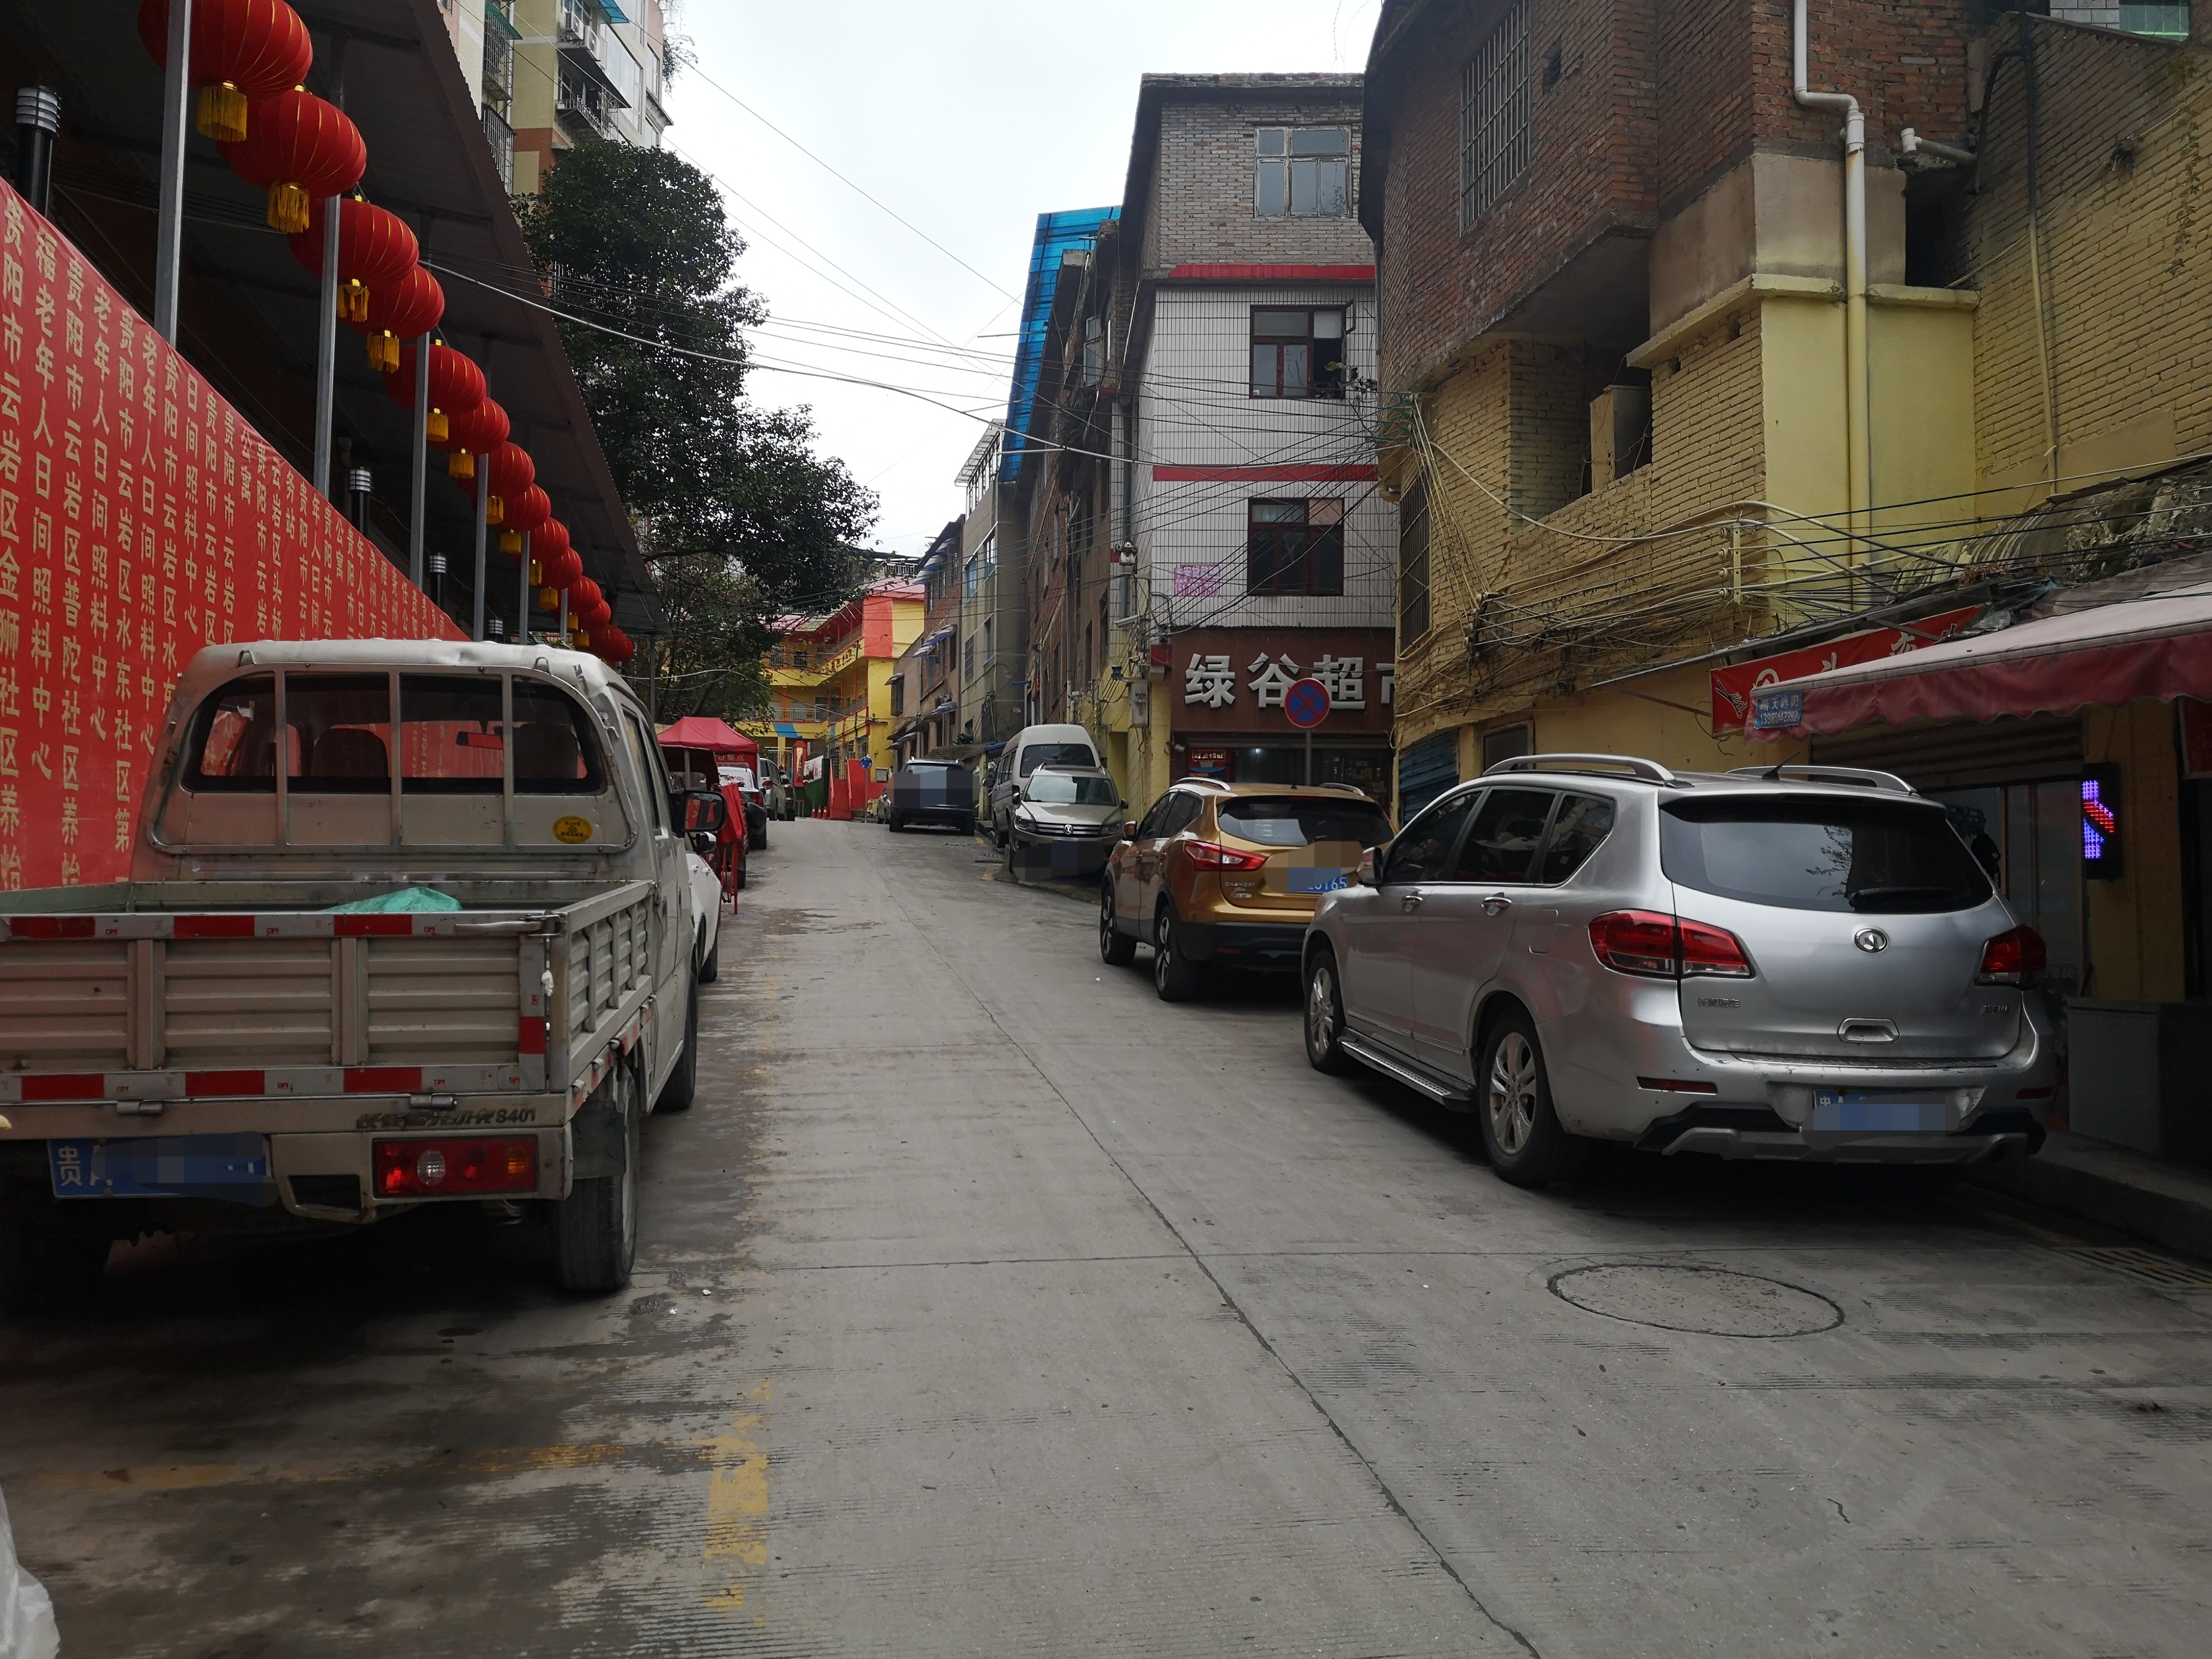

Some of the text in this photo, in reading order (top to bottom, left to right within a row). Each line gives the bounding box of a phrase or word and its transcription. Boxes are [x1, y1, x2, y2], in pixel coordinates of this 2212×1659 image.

[31, 225, 57, 780] 福老年人日间照料中心
[90, 283, 111, 741] 老年人日间照料中心
[140, 331, 157, 755] 老年人日间照料中心
[184, 372, 198, 635] 日间照料中心
[205, 391, 217, 647] 贵阳市云岩区
[224, 408, 236, 644] 贵阳市云岩区
[257, 440, 267, 641] 贵阳市云岩
[312, 492, 321, 641] 年人日间
